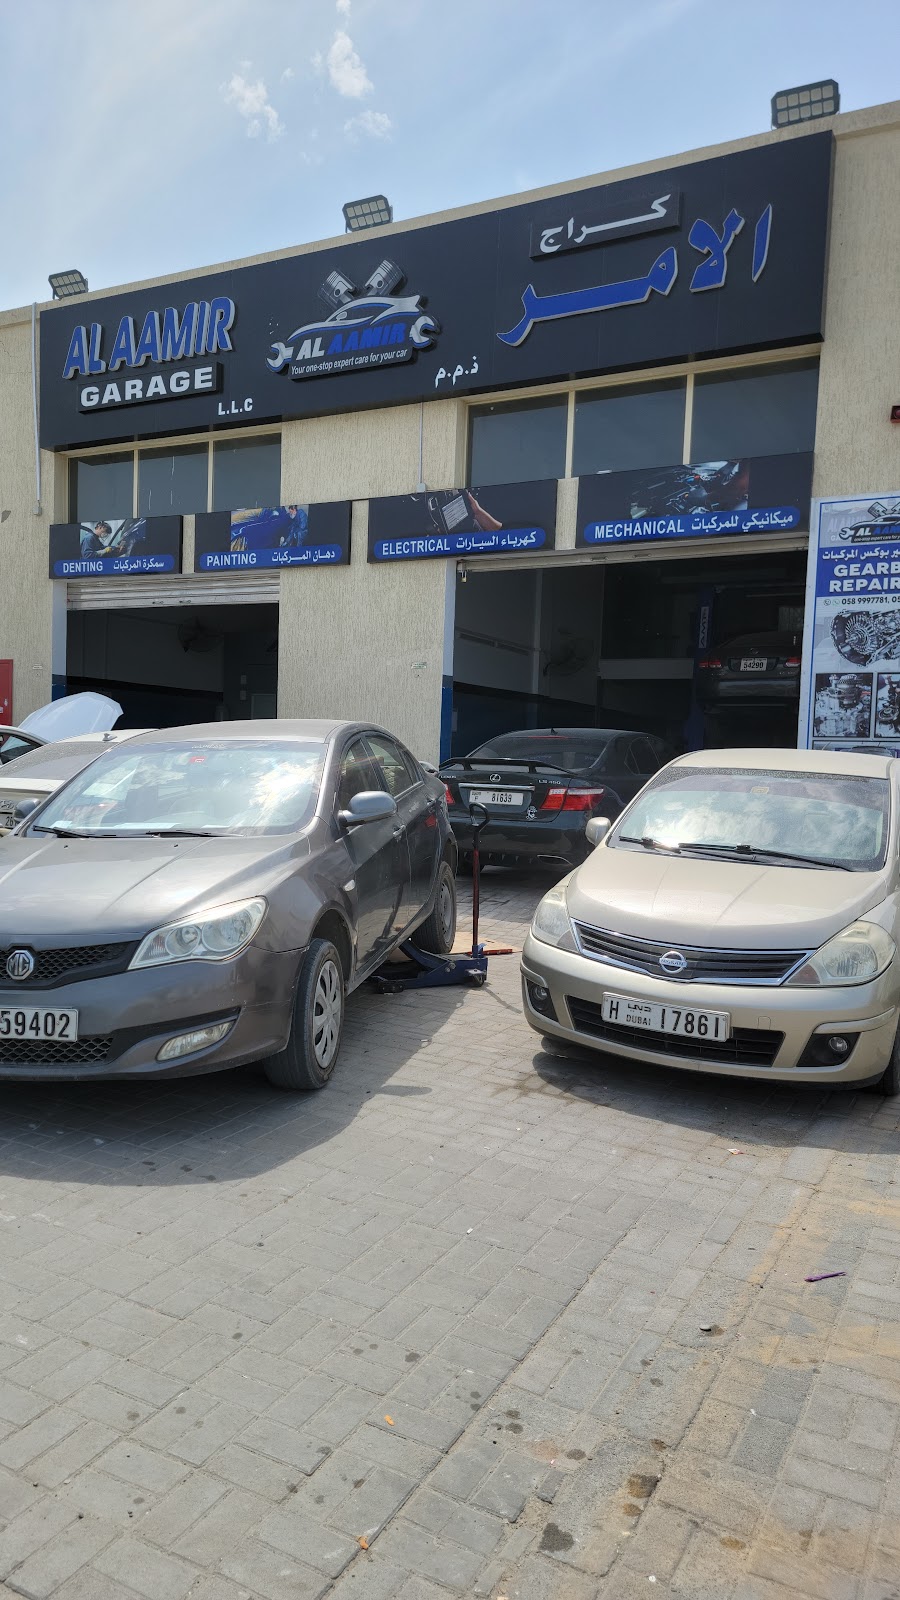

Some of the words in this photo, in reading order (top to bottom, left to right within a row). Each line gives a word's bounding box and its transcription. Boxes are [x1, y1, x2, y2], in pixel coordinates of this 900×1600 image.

[538, 193, 672, 253] كراج
[62, 322, 106, 380] AL
[108, 296, 236, 372] AAMIR
[295, 337, 325, 361] AL
[326, 322, 406, 356] AAMIR
[291, 365, 306, 375] Your
[306, 360, 333, 373] one-stop
[333, 357, 354, 369] expert
[354, 355, 369, 364] care
[369, 352, 380, 362] for
[380, 351, 395, 363] your
[396, 348, 409, 358] car
[80, 366, 213, 408] GARAGE
[218, 398, 253, 416] L.L.C
[594, 518, 685, 539] MECHANICAL
[691, 515, 739, 532] للمركبات
[741, 510, 794, 533] ميكانيكي
[501, 530, 537, 548] كهرباء
[855, 527, 872, 537] AL
[382, 538, 450, 556] ELECTRICAL
[455, 535, 499, 551] السيارات
[206, 552, 257, 567] PAINTING
[271, 550, 311, 564] المركبات
[313, 548, 336, 562] دهان
[822, 548, 858, 562] المركبات
[63, 560, 103, 573] DENTING
[113, 559, 141, 572] المركبات
[142, 557, 165, 571] سمكرة
[833, 561, 900, 577] GEARB
[829, 577, 900, 593] REPAIR
[491, 792, 513, 803] 81639
[7, 952, 30, 976] MG
[0, 1010, 70, 1039] 59402
[609, 1000, 619, 1020] H
[660, 1008, 720, 1038] 17861
[626, 1014, 651, 1026] DUBAI
